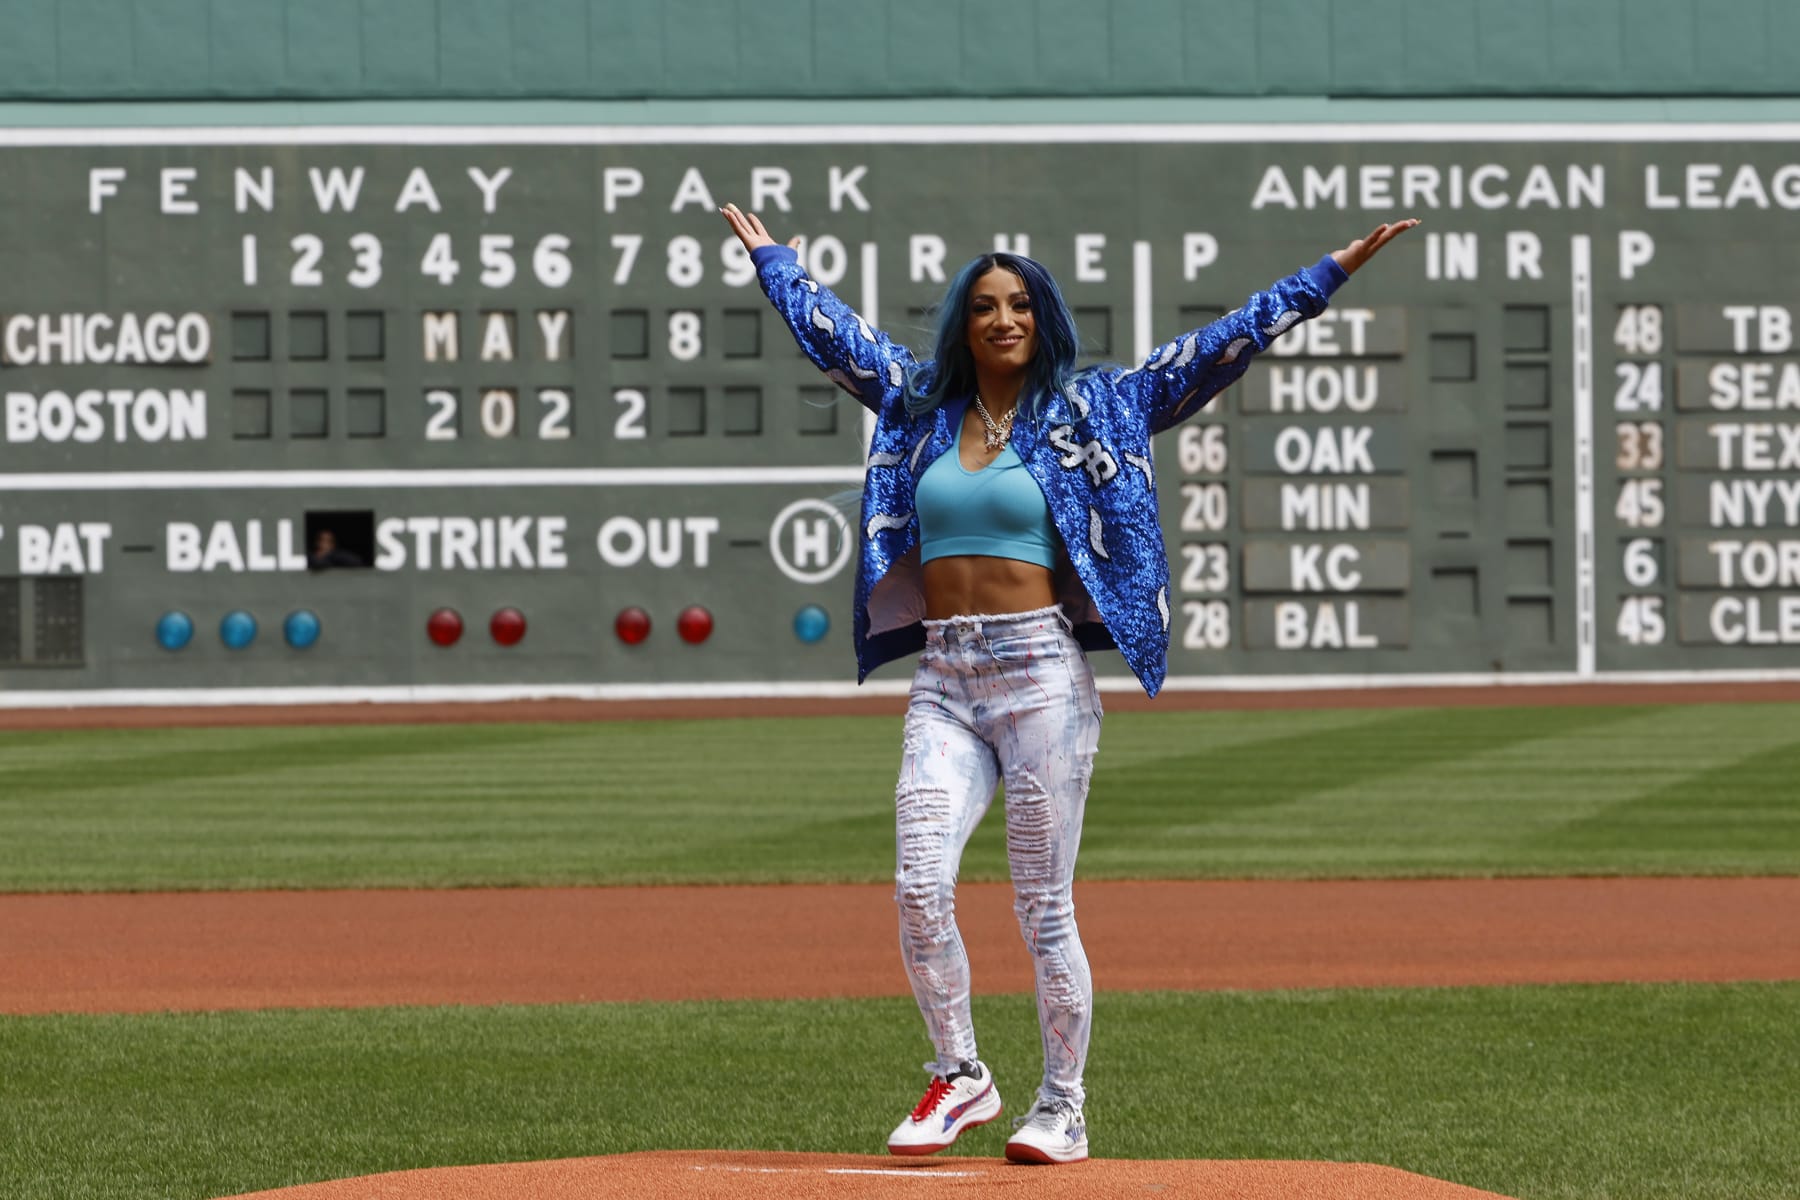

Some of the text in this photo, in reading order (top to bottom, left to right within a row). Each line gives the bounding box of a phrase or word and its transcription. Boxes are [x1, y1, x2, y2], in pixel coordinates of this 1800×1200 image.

[89, 166, 870, 214] FENWAY PARK
[1251, 164, 1604, 209] AMERICAN
[242, 234, 257, 285] 1
[290, 234, 323, 286] 2
[347, 233, 382, 288] 3
[421, 233, 460, 285] 4
[479, 234, 516, 288] 5
[533, 234, 572, 288] 6
[611, 234, 643, 285] 7
[667, 235, 703, 287] 8
[720, 234, 757, 288] 9
[909, 234, 947, 283] R
[1075, 234, 1106, 282] E
[1183, 231, 1543, 281] P IN R
[1619, 230, 1655, 280] P
[5, 312, 210, 365] CHICAGO
[668, 312, 702, 361] 8
[1615, 306, 1793, 354] 48 TB
[1270, 366, 1378, 412] HOU
[1614, 363, 1800, 411] 24 SEA
[5, 389, 207, 443] BOSTON
[1049, 424, 1118, 487] SB
[1177, 425, 1374, 474] 66 OAK
[1616, 422, 1662, 470] 33
[1180, 484, 1370, 532] 20 MIN
[1616, 480, 1663, 526] 45
[18, 516, 829, 574] BAT BALL STRIKE OUT H
[1181, 543, 1362, 592] 23 KC
[1623, 539, 1657, 587] 6
[1183, 601, 1378, 649] 28 BAL
[1617, 598, 1665, 645] 45
